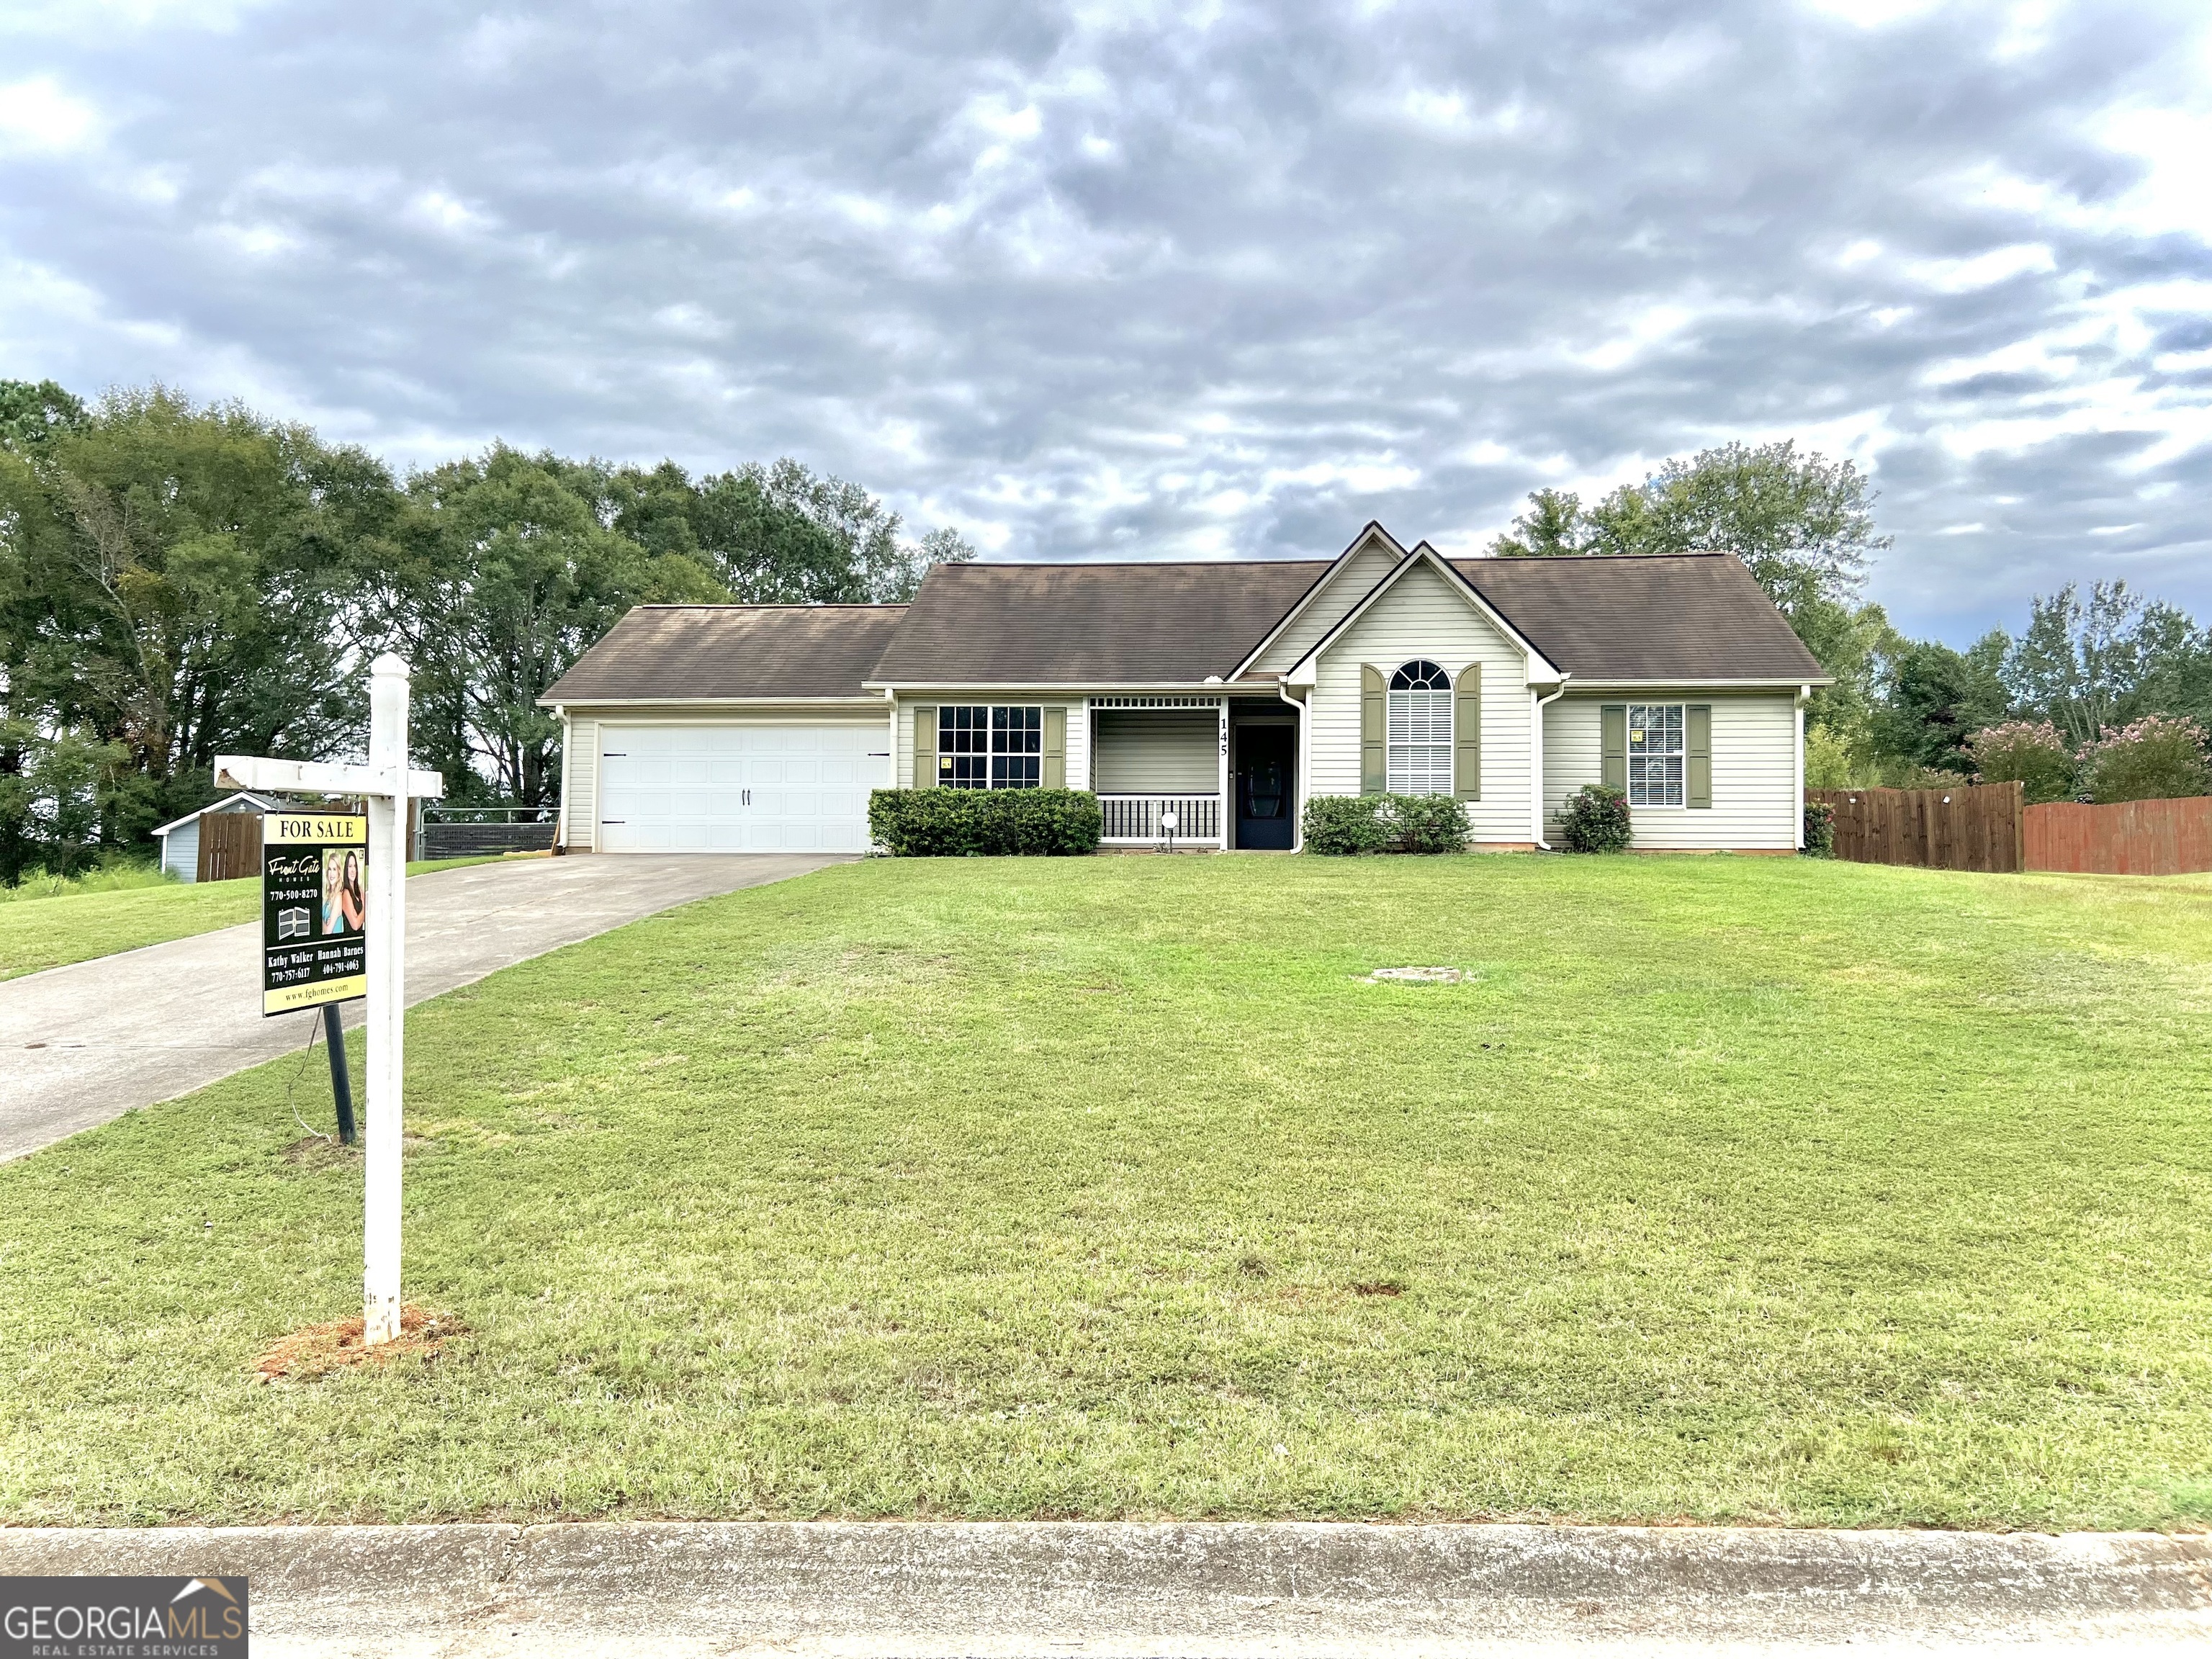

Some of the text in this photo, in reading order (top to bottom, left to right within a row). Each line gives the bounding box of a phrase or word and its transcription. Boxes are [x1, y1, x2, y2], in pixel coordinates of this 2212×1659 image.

[280, 820, 354, 838] FOR SALE
[268, 855, 320, 876] Front Gate
[270, 889, 318, 902] 770-500-8270
[268, 951, 314, 968] Kathy Walker
[318, 945, 364, 961] Hannah Barnes
[323, 959, 359, 974] 404-791-4063
[271, 967, 310, 984] 770-757-6117
[285, 984, 349, 1001] www.fghomes.com
